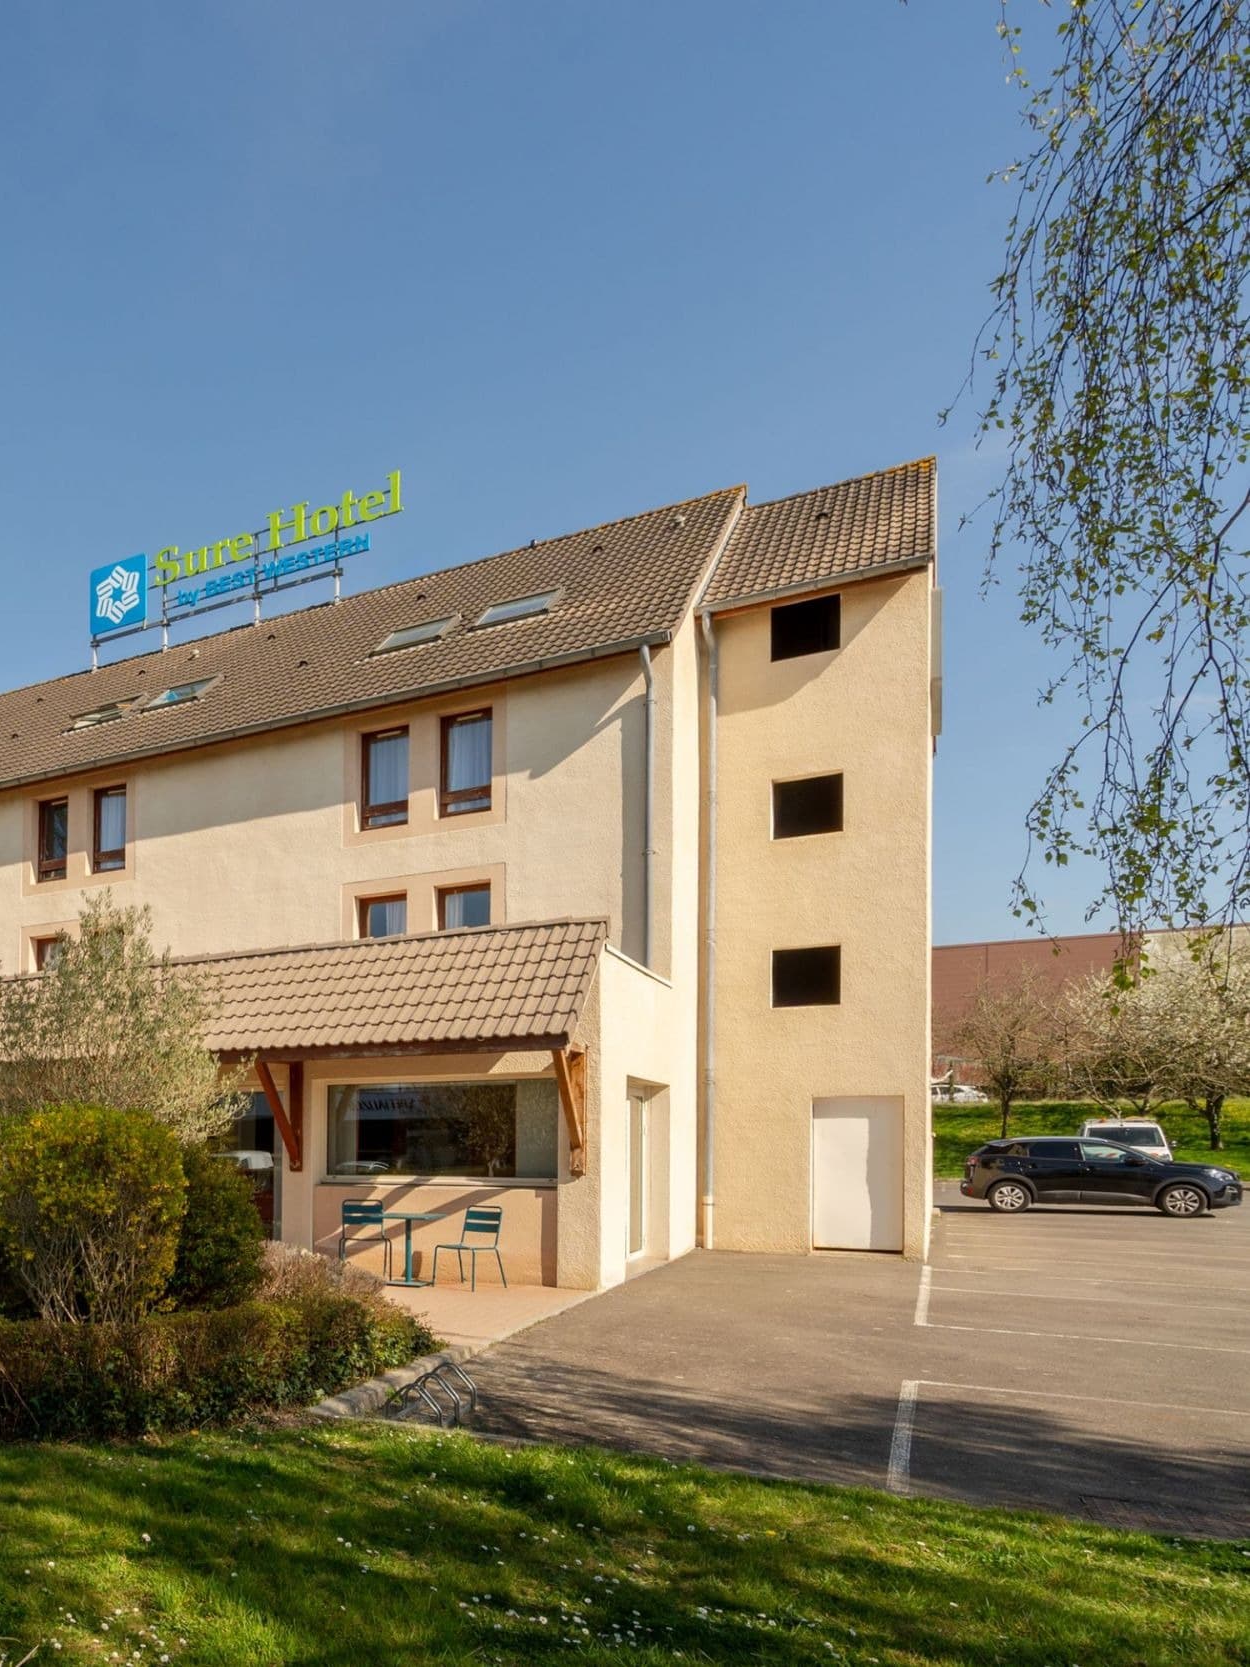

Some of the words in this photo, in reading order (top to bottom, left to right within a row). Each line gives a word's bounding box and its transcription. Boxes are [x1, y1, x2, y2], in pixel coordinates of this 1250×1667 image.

[154, 532, 254, 586] Sure
[265, 469, 404, 550] Hotel
[177, 588, 199, 606] by
[205, 567, 257, 595] BEST
[263, 532, 370, 578] WESTERN
